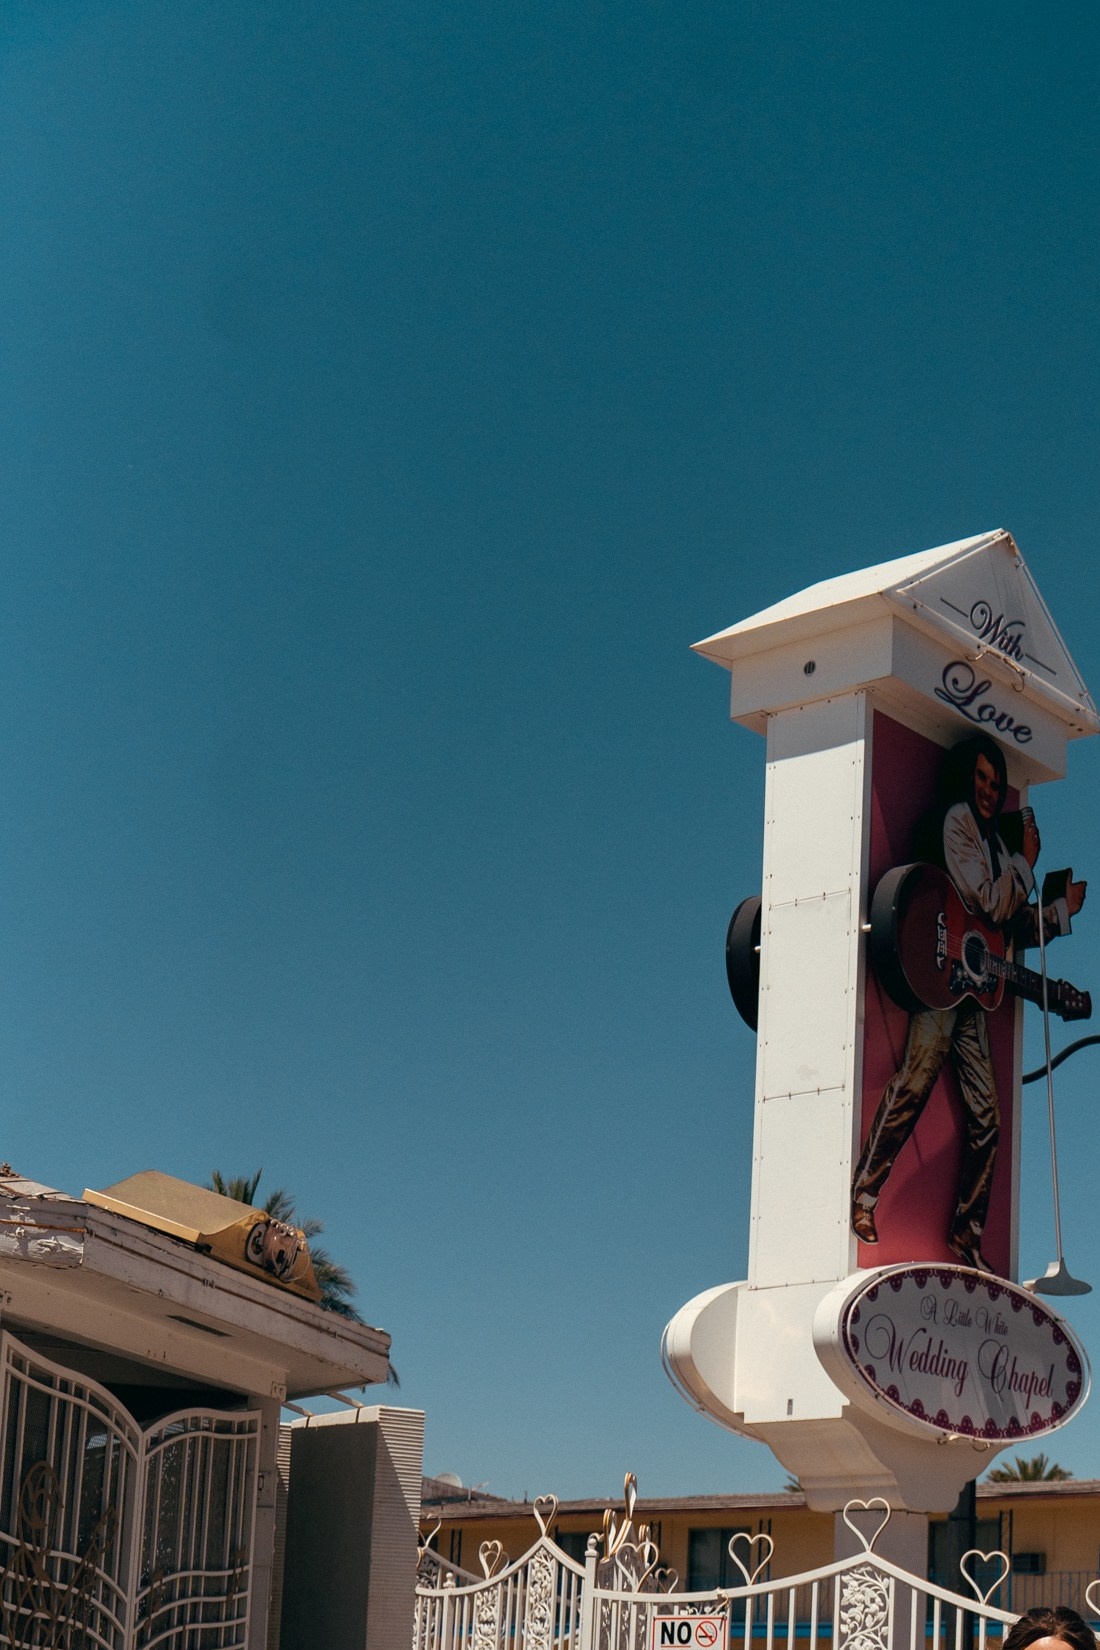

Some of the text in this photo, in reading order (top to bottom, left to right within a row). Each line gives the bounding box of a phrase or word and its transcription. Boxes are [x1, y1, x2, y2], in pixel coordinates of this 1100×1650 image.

[970, 600, 1026, 662] With
[934, 660, 1033, 744] Love
[920, 1294, 1009, 1336] A Little White
[864, 1313, 1055, 1410] Wedding Chapel
[660, 1621, 692, 1645] NO
